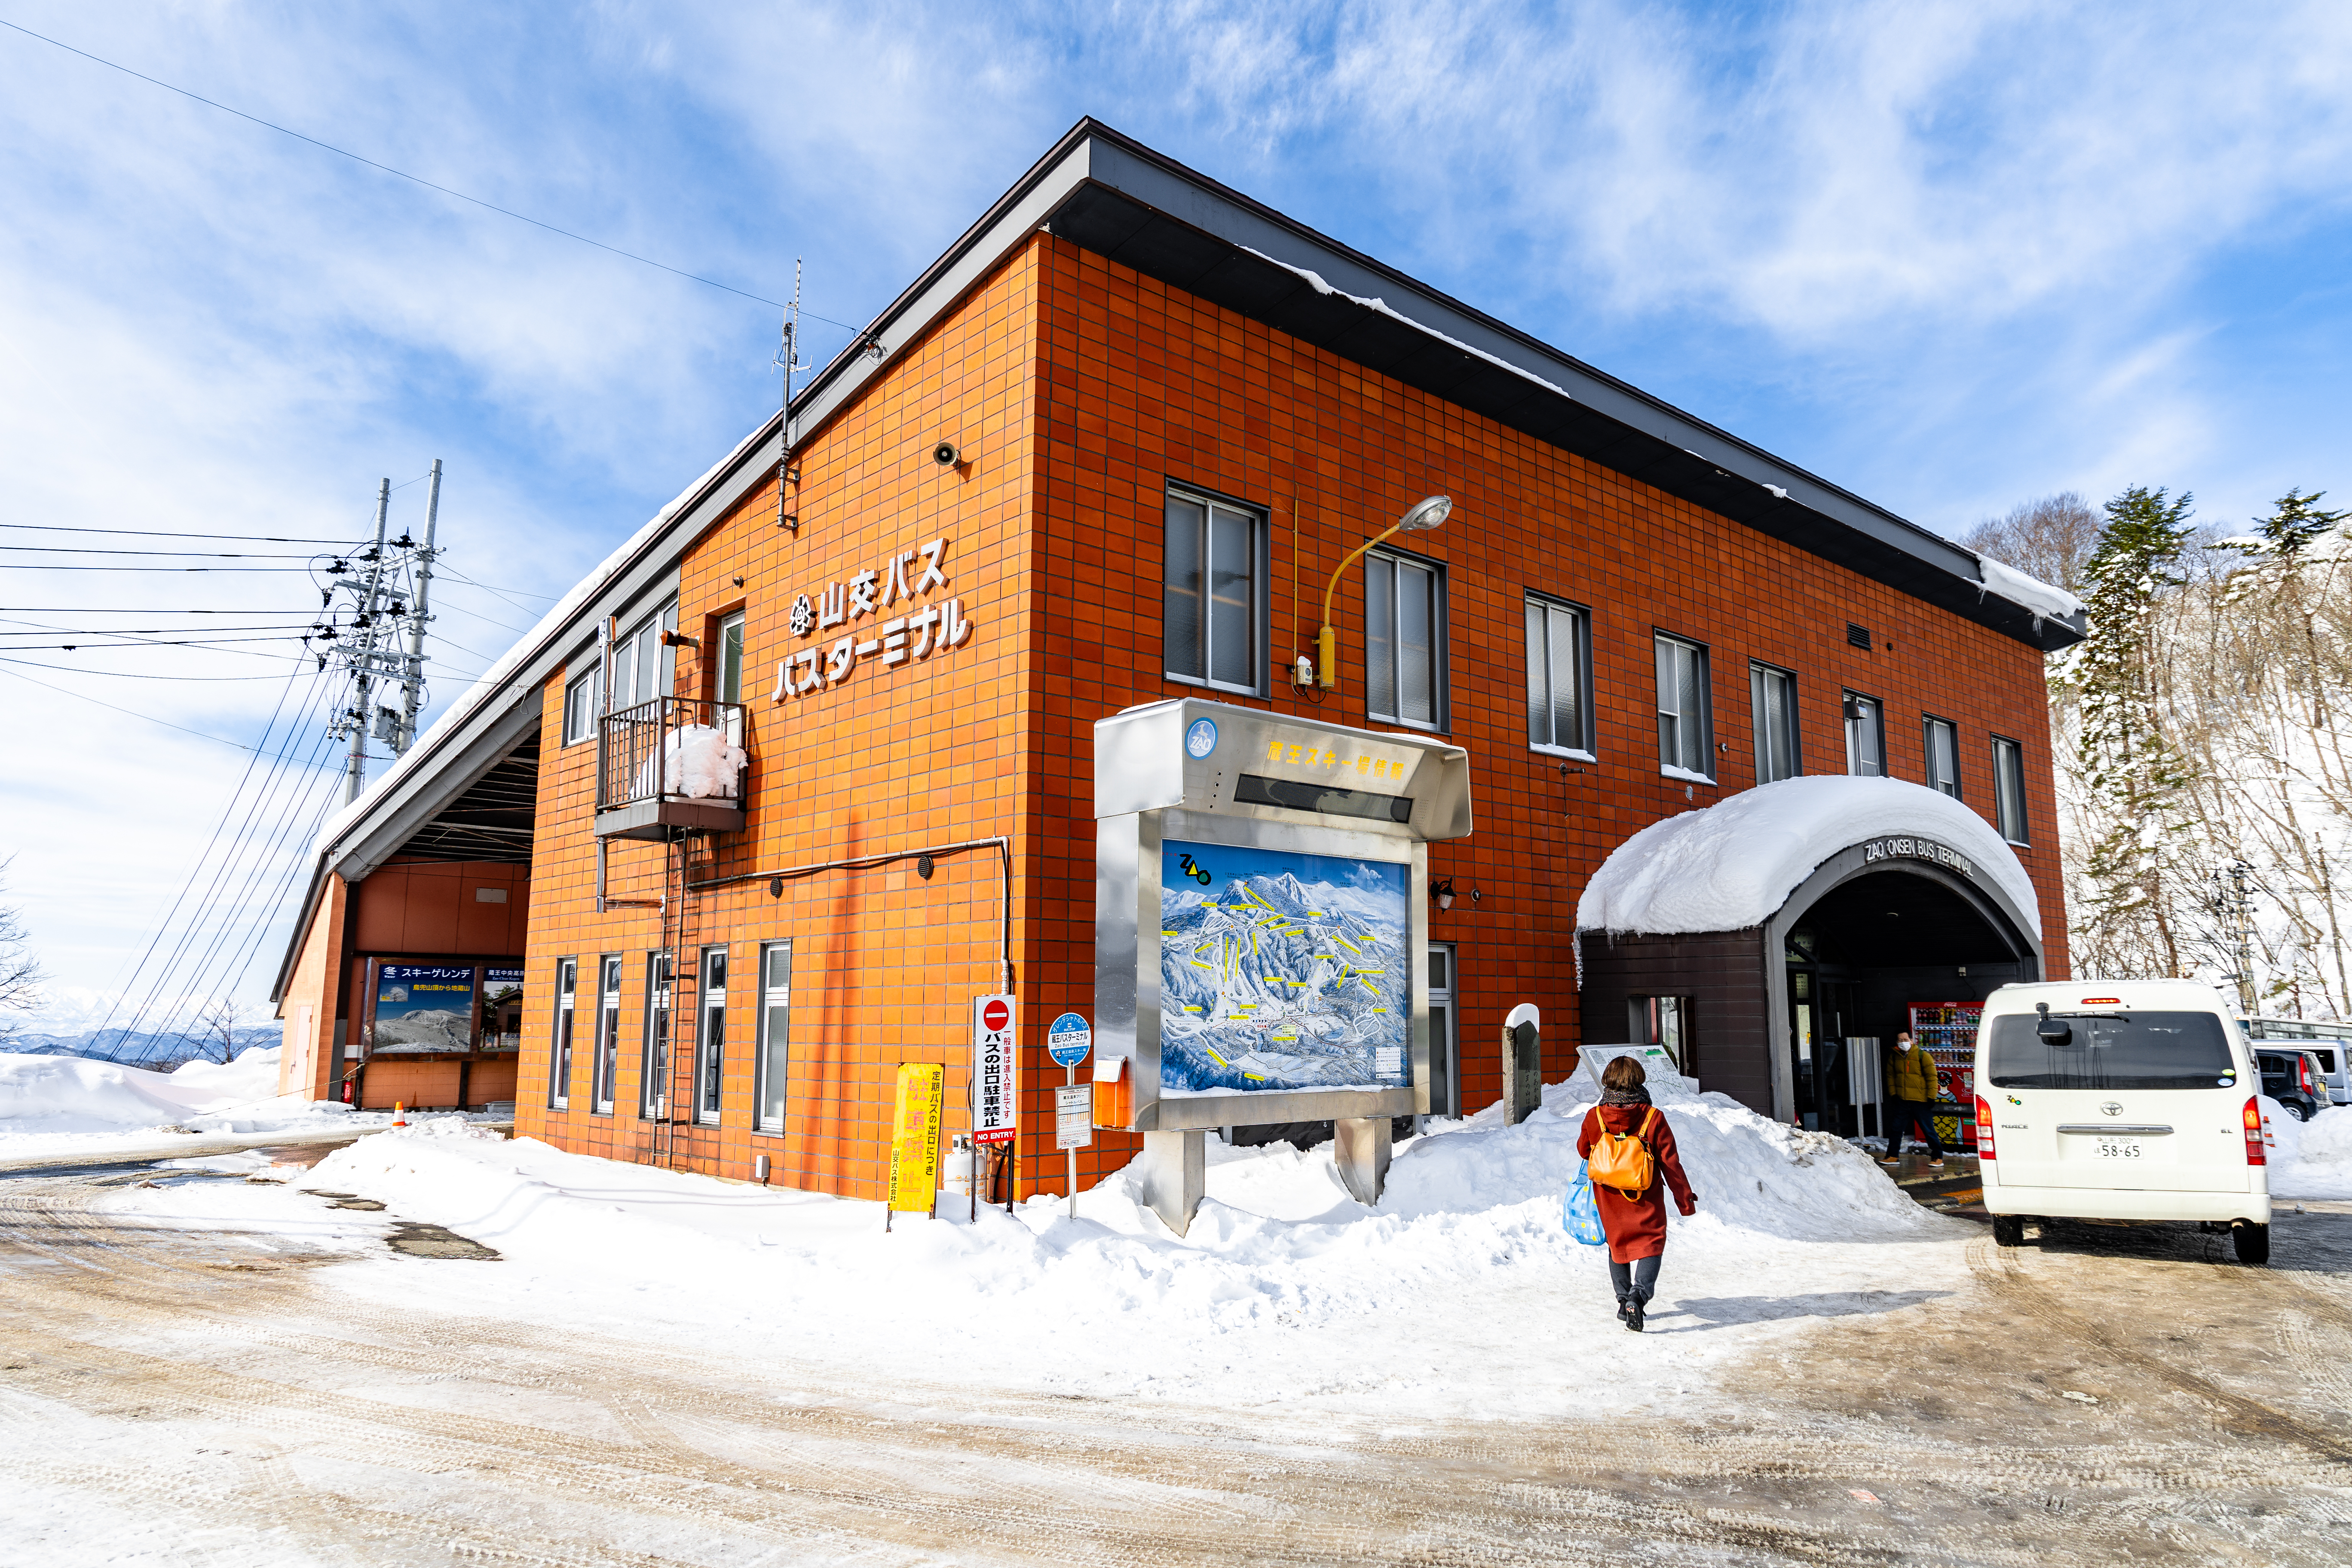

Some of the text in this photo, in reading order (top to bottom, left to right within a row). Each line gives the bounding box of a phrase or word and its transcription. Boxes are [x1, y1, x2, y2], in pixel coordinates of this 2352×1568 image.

[819, 538, 948, 630] 山交バス
[772, 598, 972, 702] バスターミナル
[1190, 736, 1211, 751] ZAO
[1267, 741, 1404, 781] 蔵王スキー場情報
[1865, 839, 1973, 877] ZAO ONSEN BUS TERMINAL
[384, 966, 397, 975] 冬
[401, 968, 471, 978] スキーゲレンデ
[1052, 1032, 1088, 1043] 蔵王バスターミナル
[1053, 1016, 1087, 1033] ゲレンデシャトルバス
[983, 1032, 1001, 1127] バスの出口駐車禁止
[900, 1078, 929, 1192] 駐車禁止
[926, 1071, 940, 1176] 定期バスの出口につき
[990, 1130, 1014, 1139] ENTRY
[2102, 1145, 2140, 1157] 58-65
[890, 1150, 899, 1202] 山交バス株式会社
